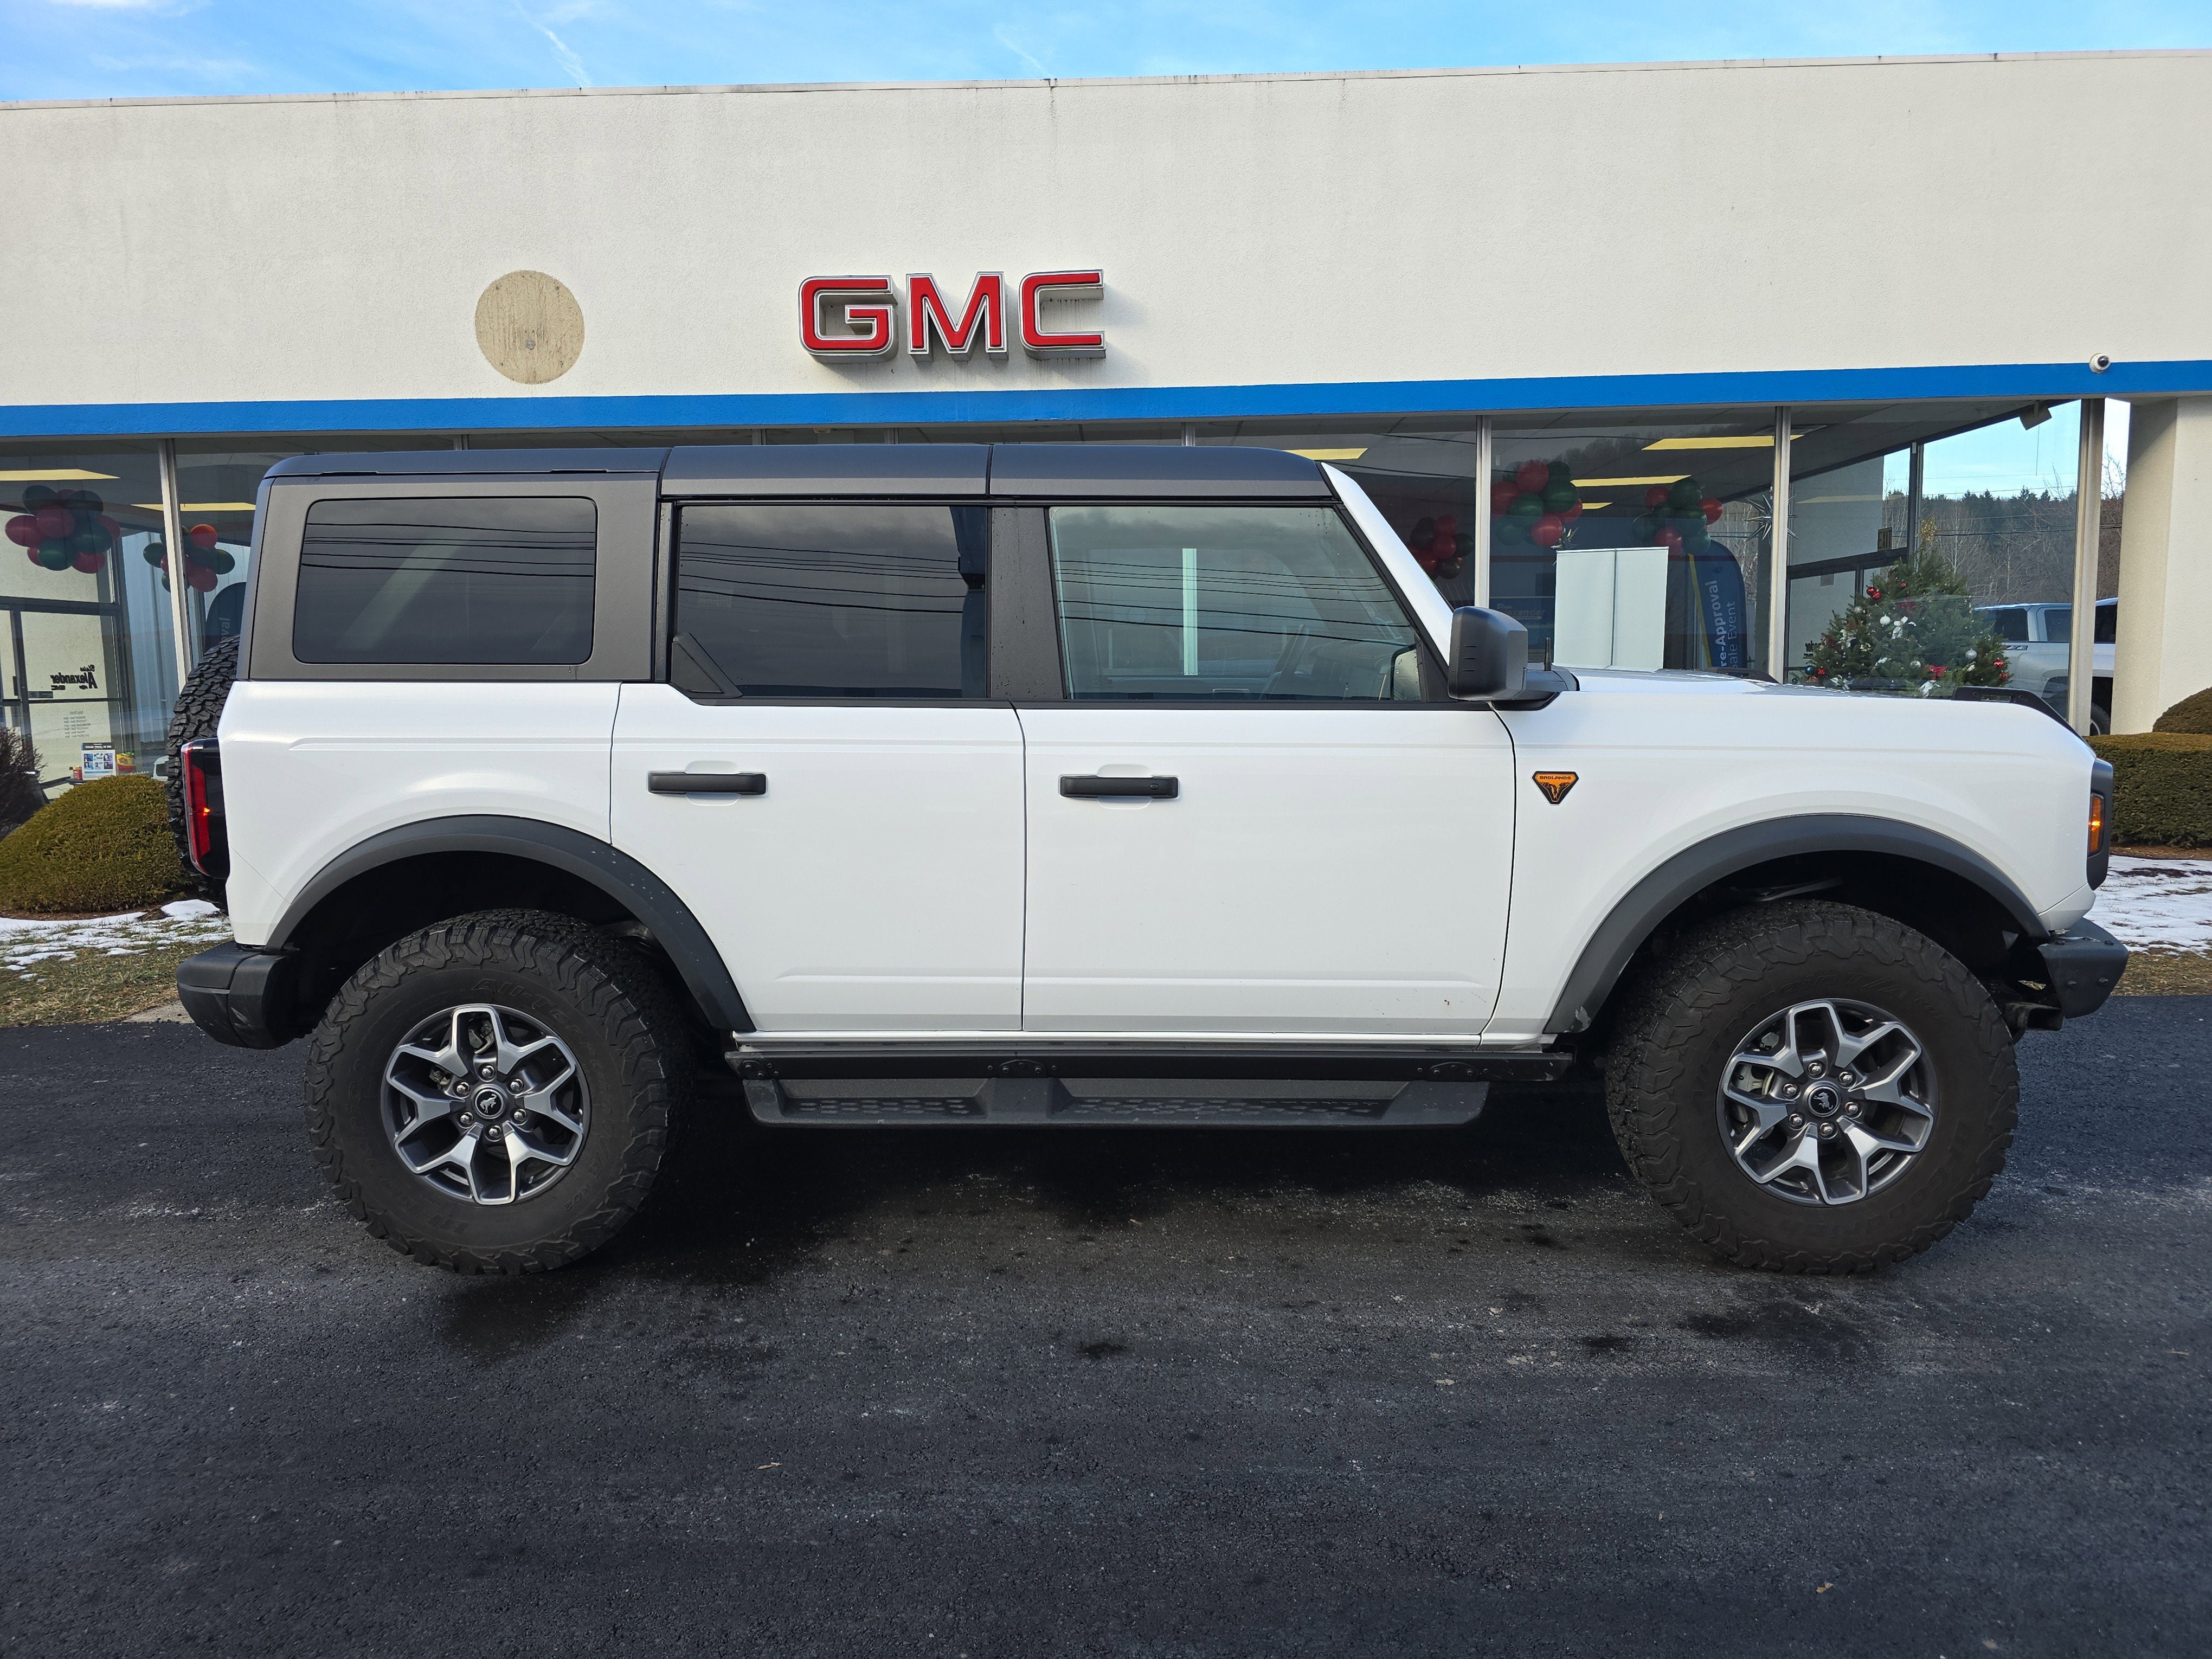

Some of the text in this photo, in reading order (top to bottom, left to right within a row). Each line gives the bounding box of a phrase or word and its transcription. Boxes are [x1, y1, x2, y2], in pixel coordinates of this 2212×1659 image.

[798, 269, 1106, 359] GMC
[1877, 530, 1892, 549] EXIT
[1705, 580, 1728, 667] re-Approval
[1726, 601, 1738, 639] Event
